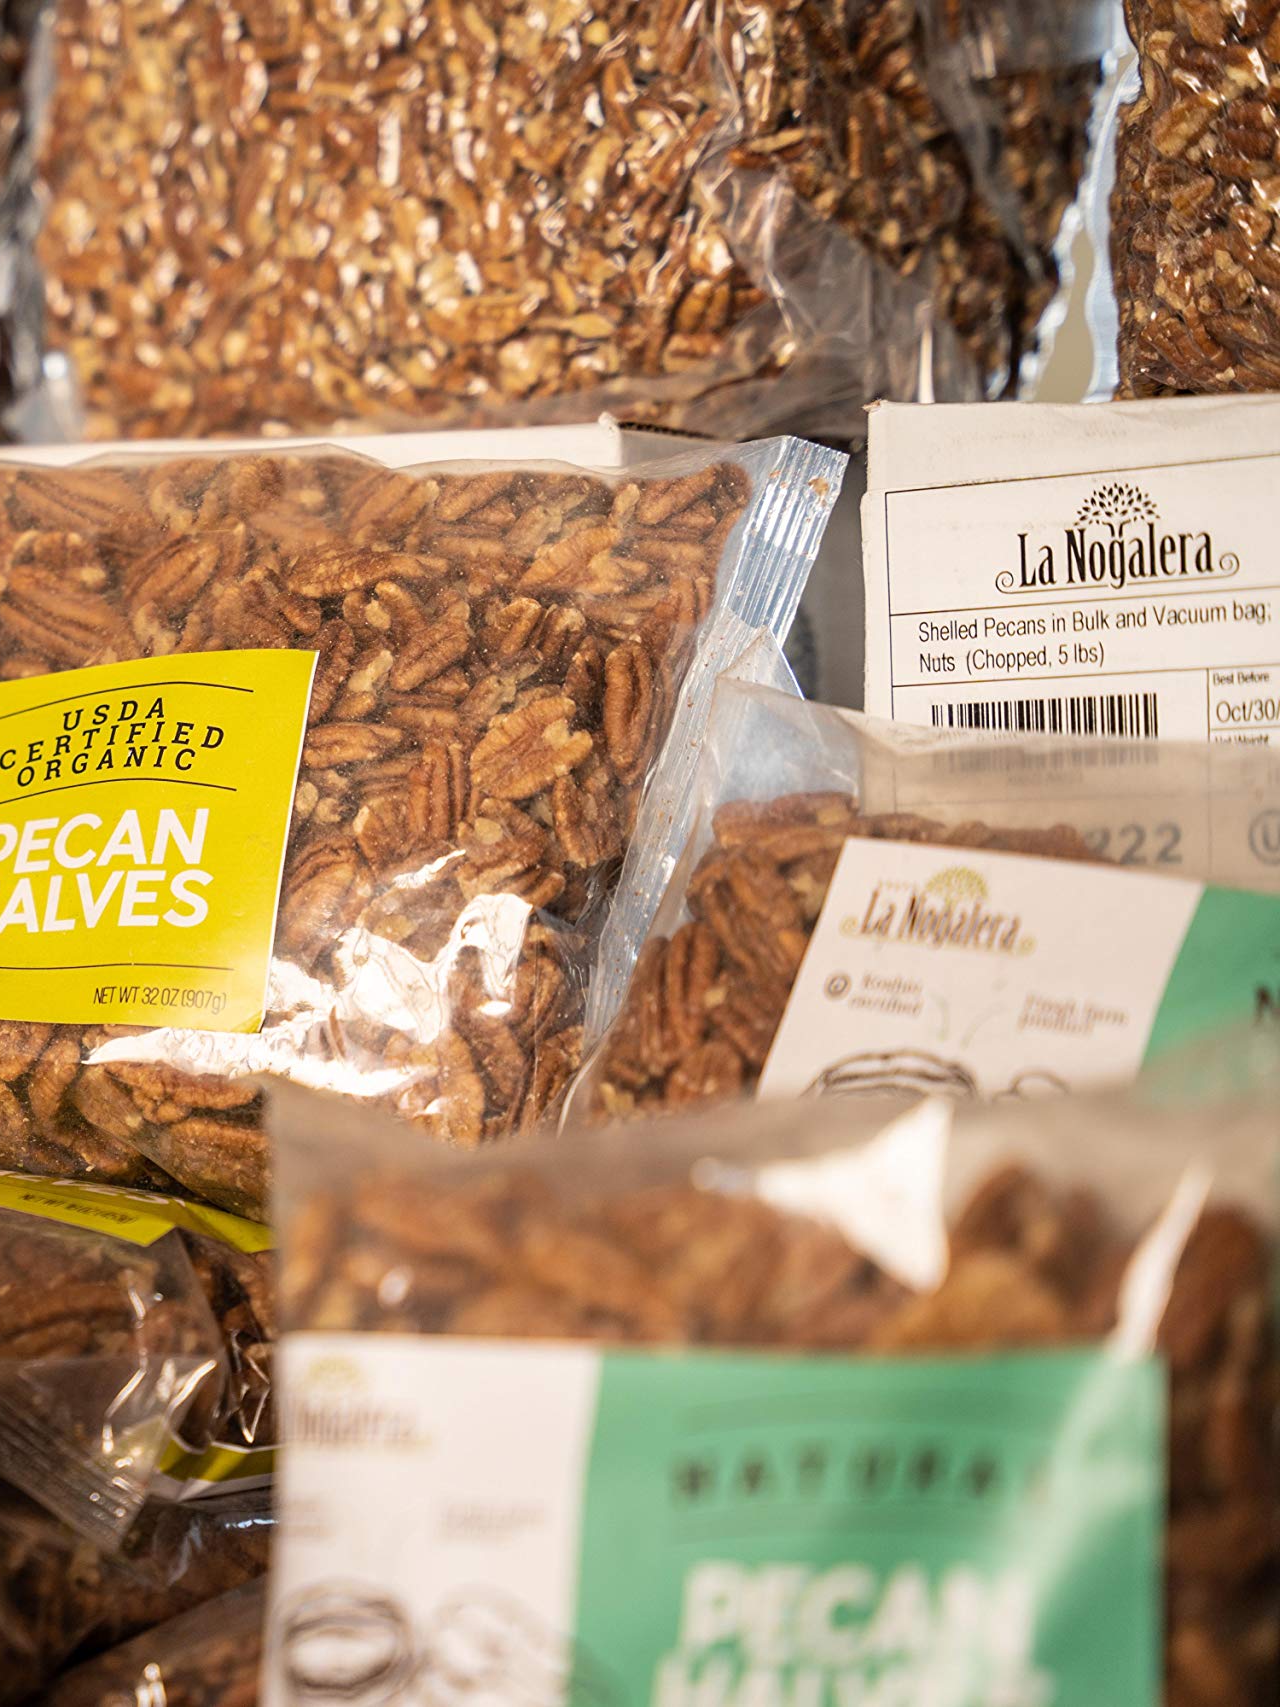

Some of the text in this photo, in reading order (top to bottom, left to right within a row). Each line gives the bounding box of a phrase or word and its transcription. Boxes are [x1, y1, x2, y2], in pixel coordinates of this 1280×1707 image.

[1017, 523, 1214, 590] La Nogalera
[918, 599, 1272, 643] Shelled Pecans in Bulk and Vacuum bag;
[919, 641, 1105, 676] Nuts (Chopped, 5 lbs)
[62, 697, 166, 732] USDA
[0, 722, 225, 770] CERTIFIED
[17, 747, 196, 787] ORGANIC
[93, 986, 227, 1015] NET WT 32 OZ (907g)
